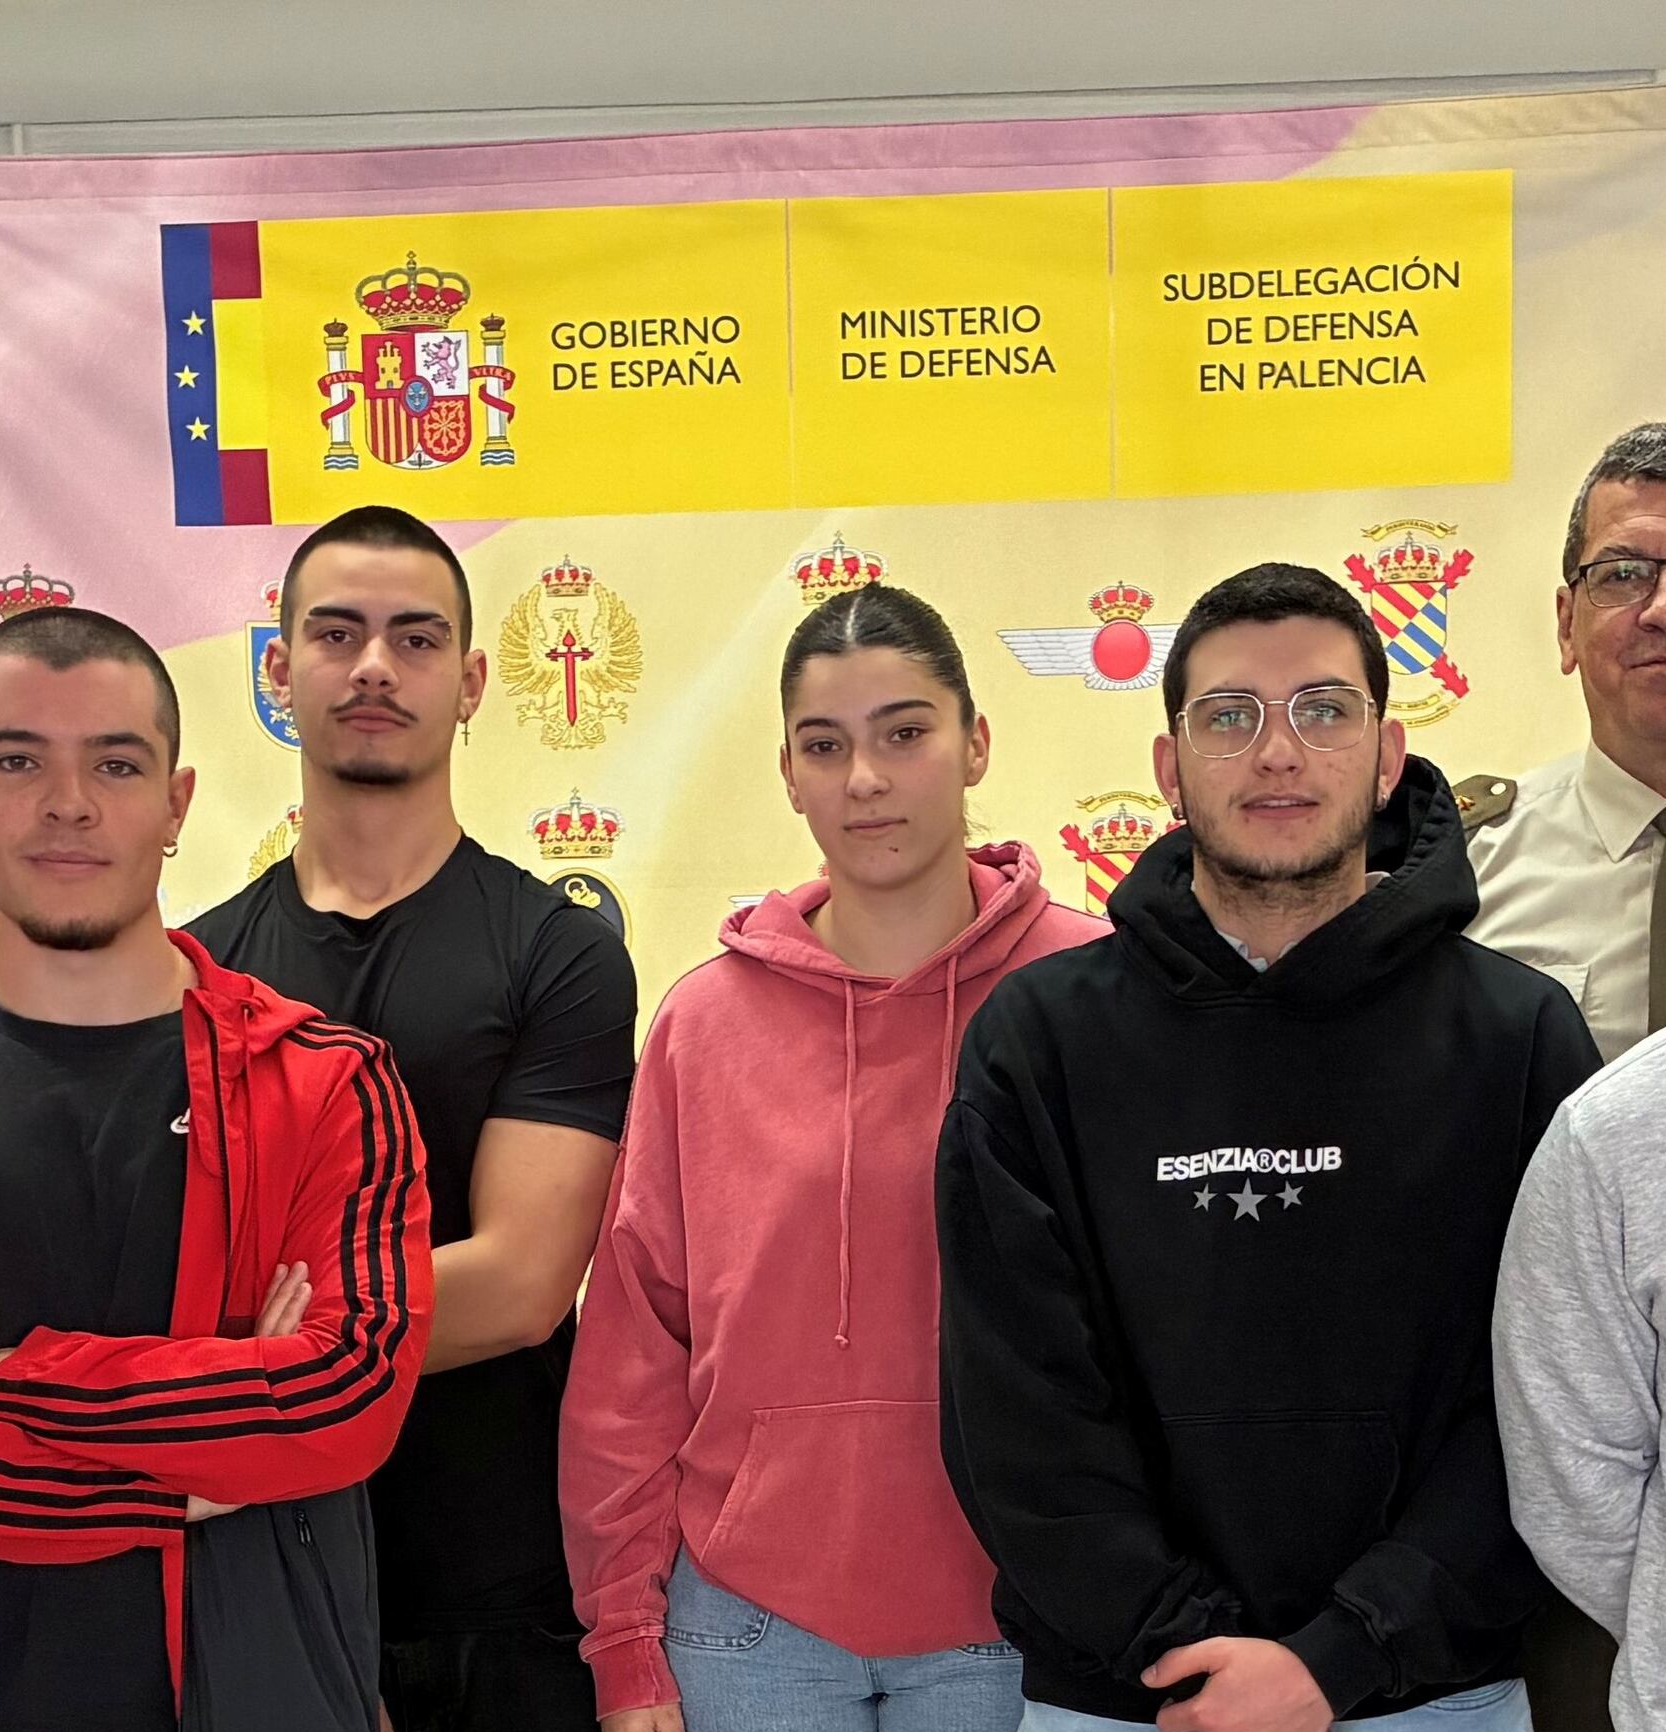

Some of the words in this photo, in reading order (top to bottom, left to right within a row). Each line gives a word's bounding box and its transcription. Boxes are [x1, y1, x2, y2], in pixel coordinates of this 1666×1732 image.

[1164, 255, 1459, 302] SUBDELEGACIÓN
[551, 315, 740, 350] GOBIERNO
[841, 305, 1041, 339] MINISTERIO
[1207, 317, 1252, 345] DE
[1265, 309, 1418, 343] DEFENSA
[553, 362, 598, 391] DE
[611, 351, 741, 388] ESPAÑA
[842, 352, 887, 380] DE
[900, 346, 1056, 378] DEFENSA
[1200, 363, 1244, 392] EN
[1259, 356, 1426, 390] PALENCIA
